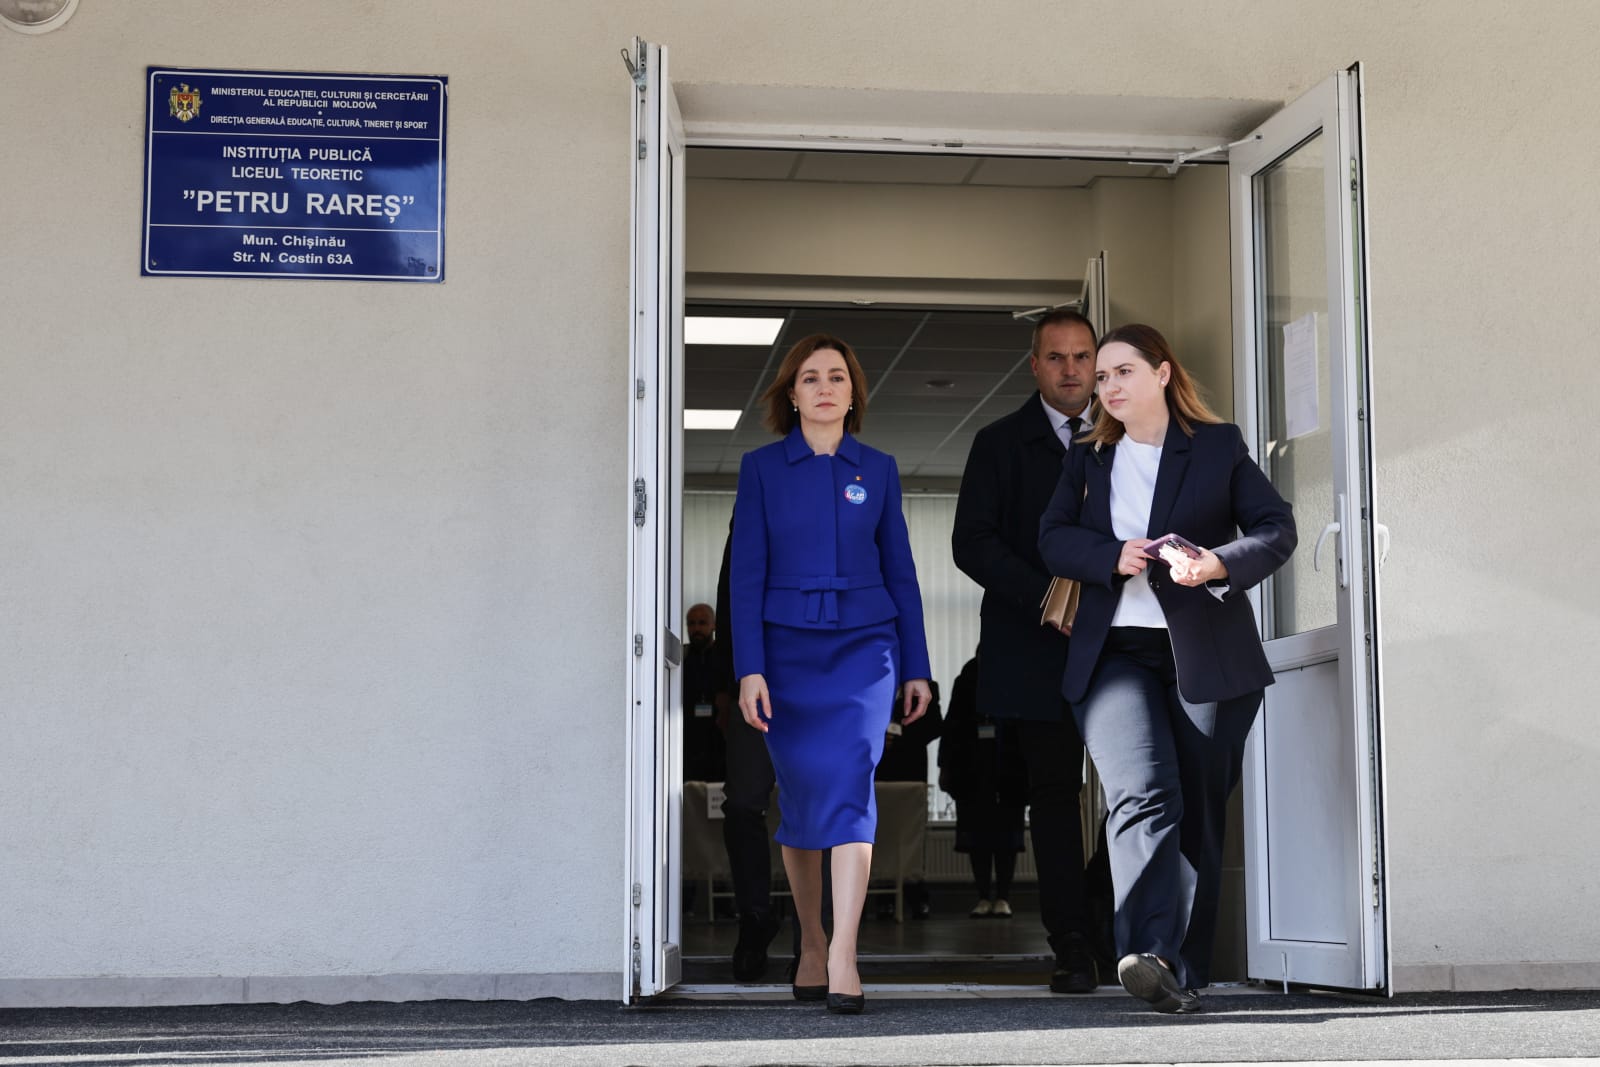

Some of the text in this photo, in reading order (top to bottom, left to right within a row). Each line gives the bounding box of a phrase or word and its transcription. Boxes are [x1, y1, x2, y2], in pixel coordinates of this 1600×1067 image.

[211, 87, 429, 102] MINISTERUL EDUCAȚIEI, CULTURII ȘI CERCETĂRII
[262, 99, 378, 109] AL REPUBLICII MOLDOVA
[210, 115, 429, 131] DIRECȚIA GENERALĂ EDUCAȚIE, CULTURĂ, TINERET ȘI SPORT
[222, 145, 373, 163] INSTITUȚIA PUBLICĂ
[231, 166, 363, 181] LICEUL TEORETIC
[242, 234, 346, 250] Mun. Chișinău
[232, 251, 354, 265] Str. N. Costin 63A
